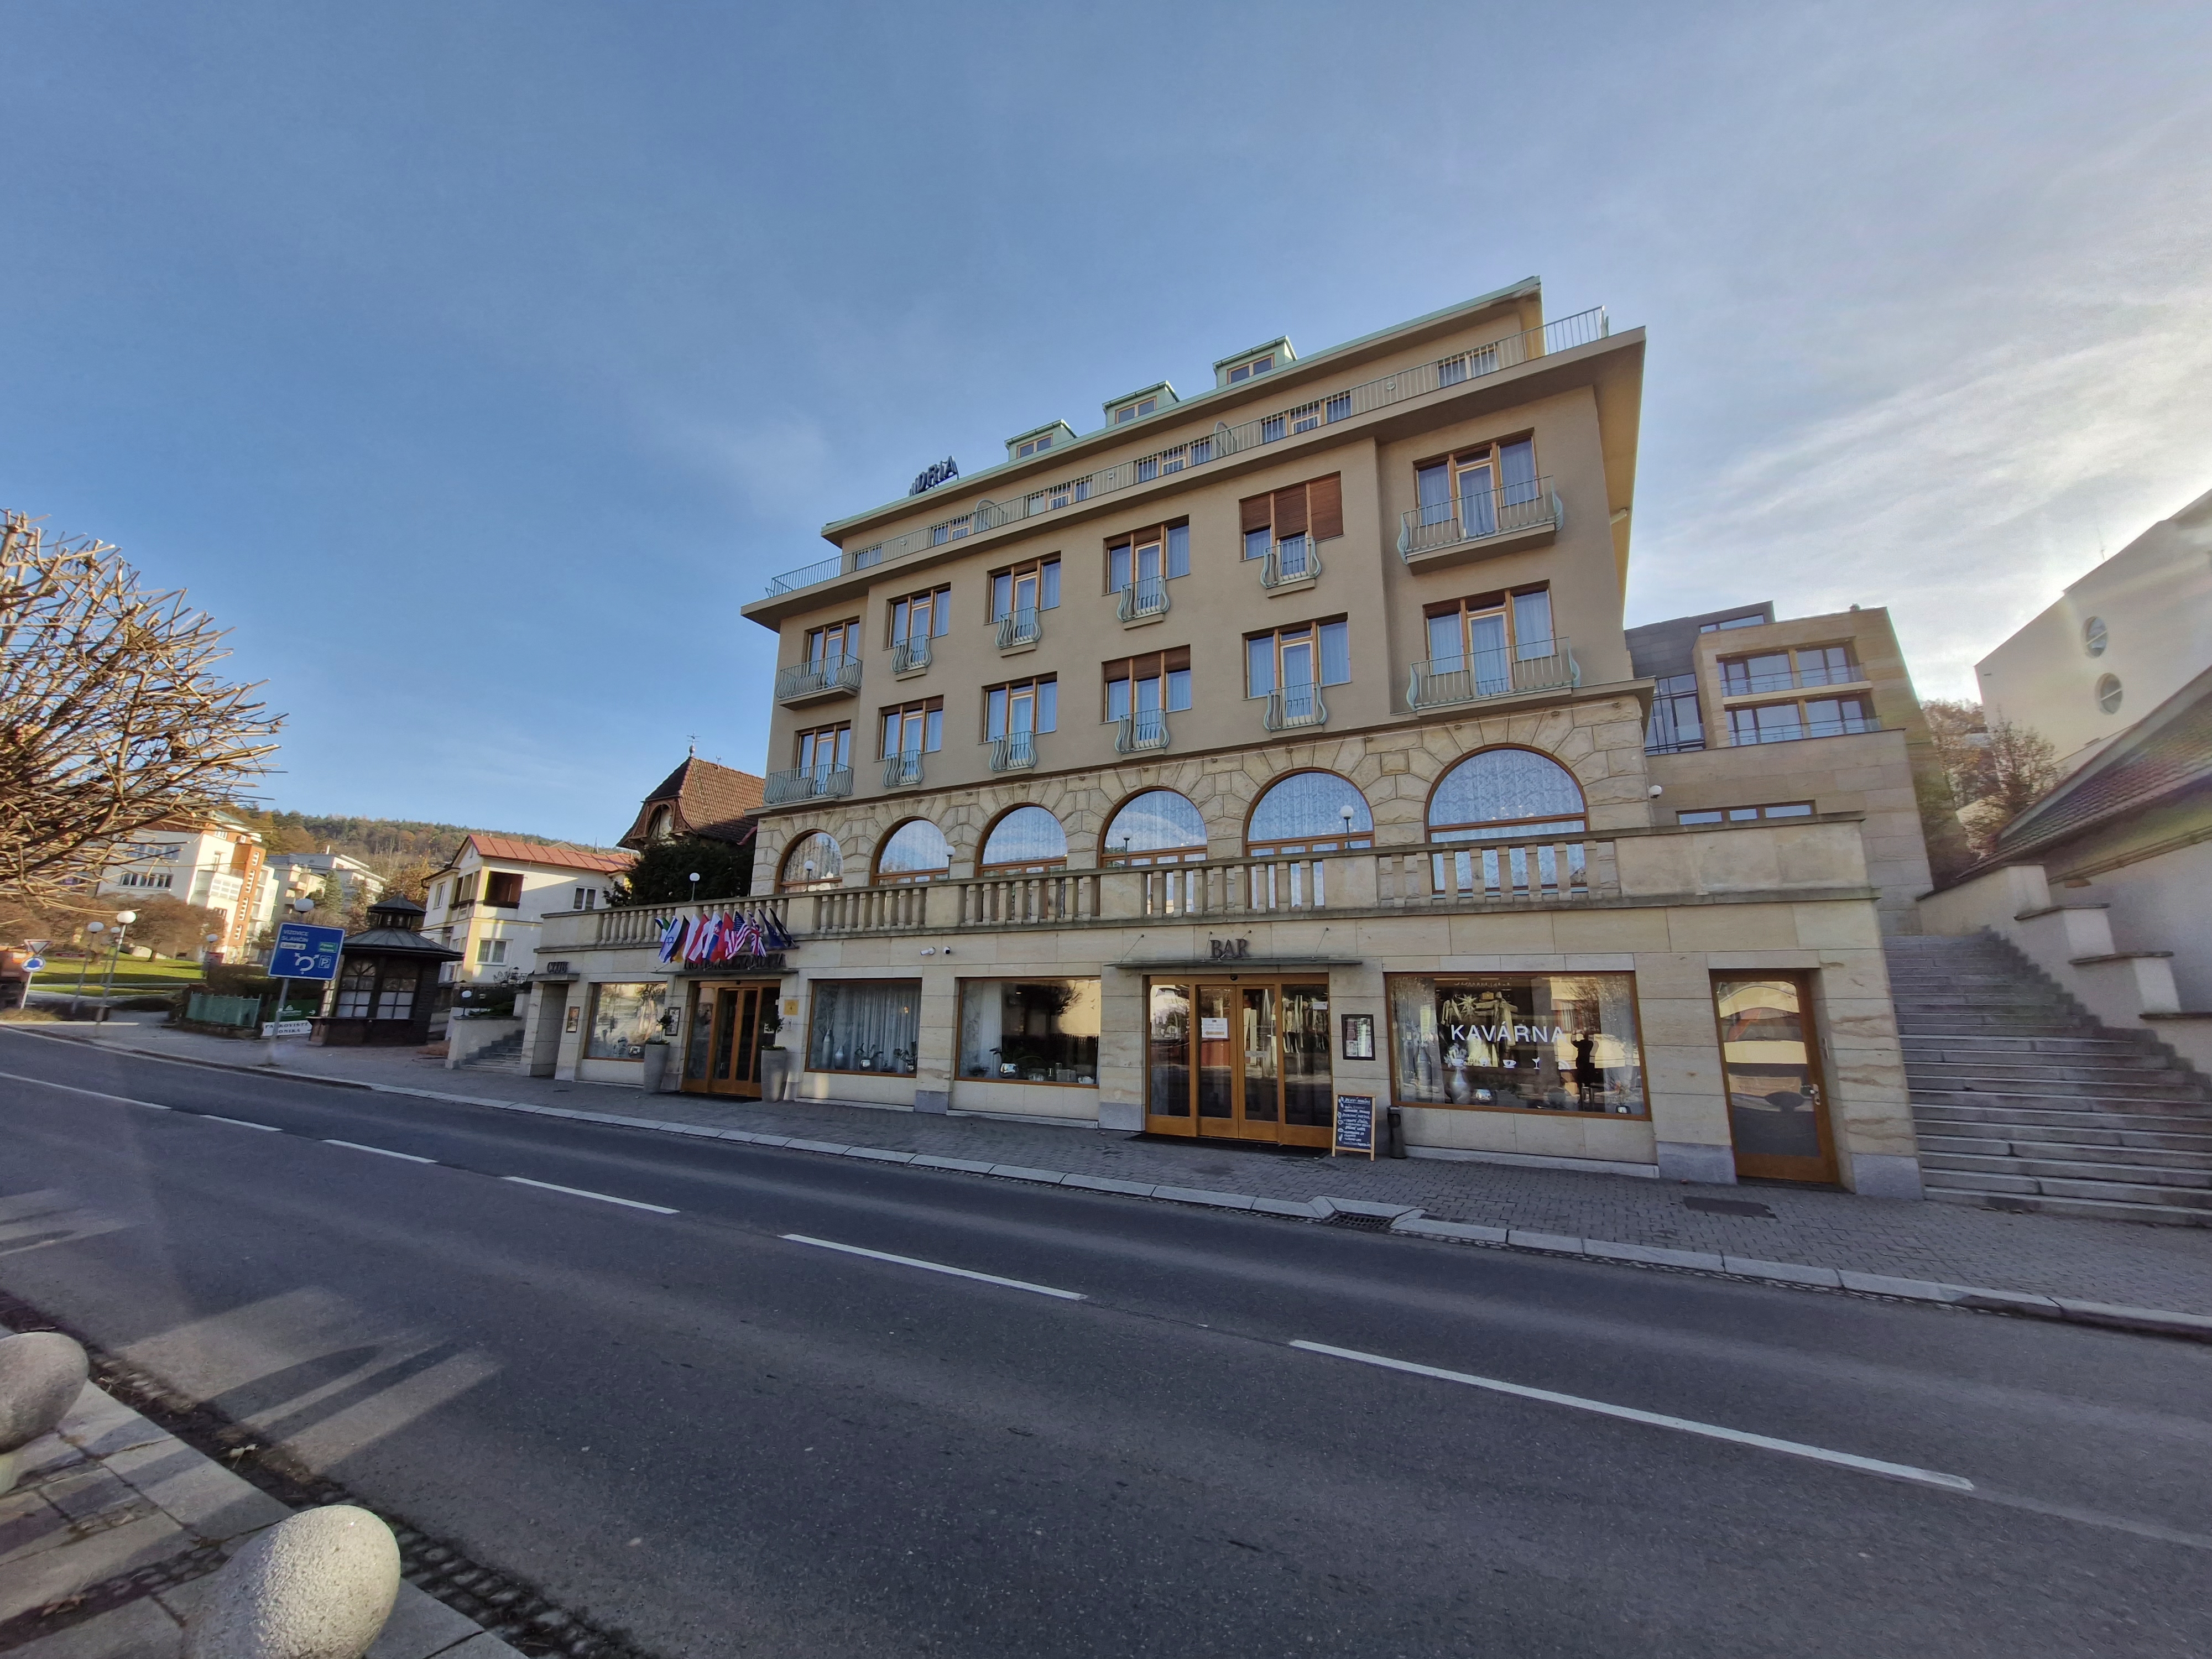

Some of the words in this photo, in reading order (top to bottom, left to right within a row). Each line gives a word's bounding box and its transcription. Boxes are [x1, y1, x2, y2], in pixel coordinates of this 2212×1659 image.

[909, 455, 958, 497] NDRIA
[1209, 938, 1250, 958] BAR
[1451, 1021, 1567, 1044] KAVÁRNA
